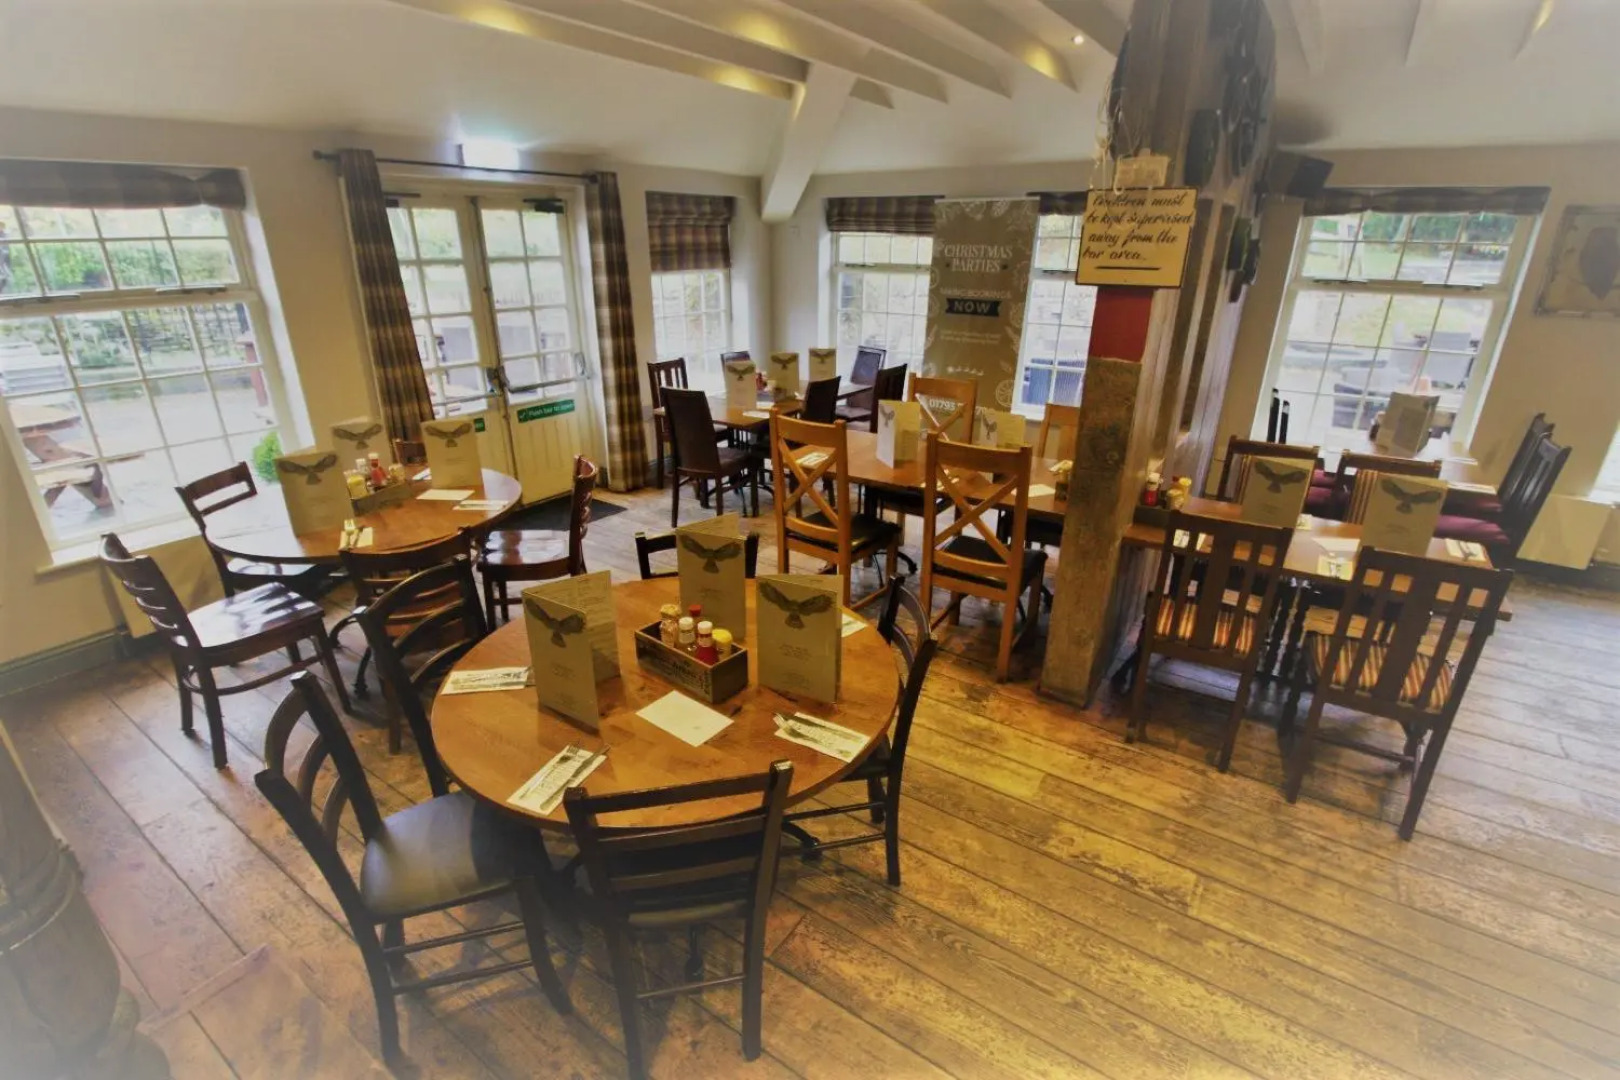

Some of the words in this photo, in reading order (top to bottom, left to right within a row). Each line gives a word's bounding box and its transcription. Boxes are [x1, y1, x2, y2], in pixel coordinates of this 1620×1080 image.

[1151, 192, 1188, 206] must
[1087, 209, 1098, 222] be
[1088, 231, 1120, 247] away
[1121, 229, 1154, 248] from
[1156, 228, 1178, 244] the
[944, 244, 1013, 259] CHRISTMAS
[1082, 246, 1105, 259] bar
[951, 258, 1001, 273] PARTIES
[953, 301, 991, 313] NOW
